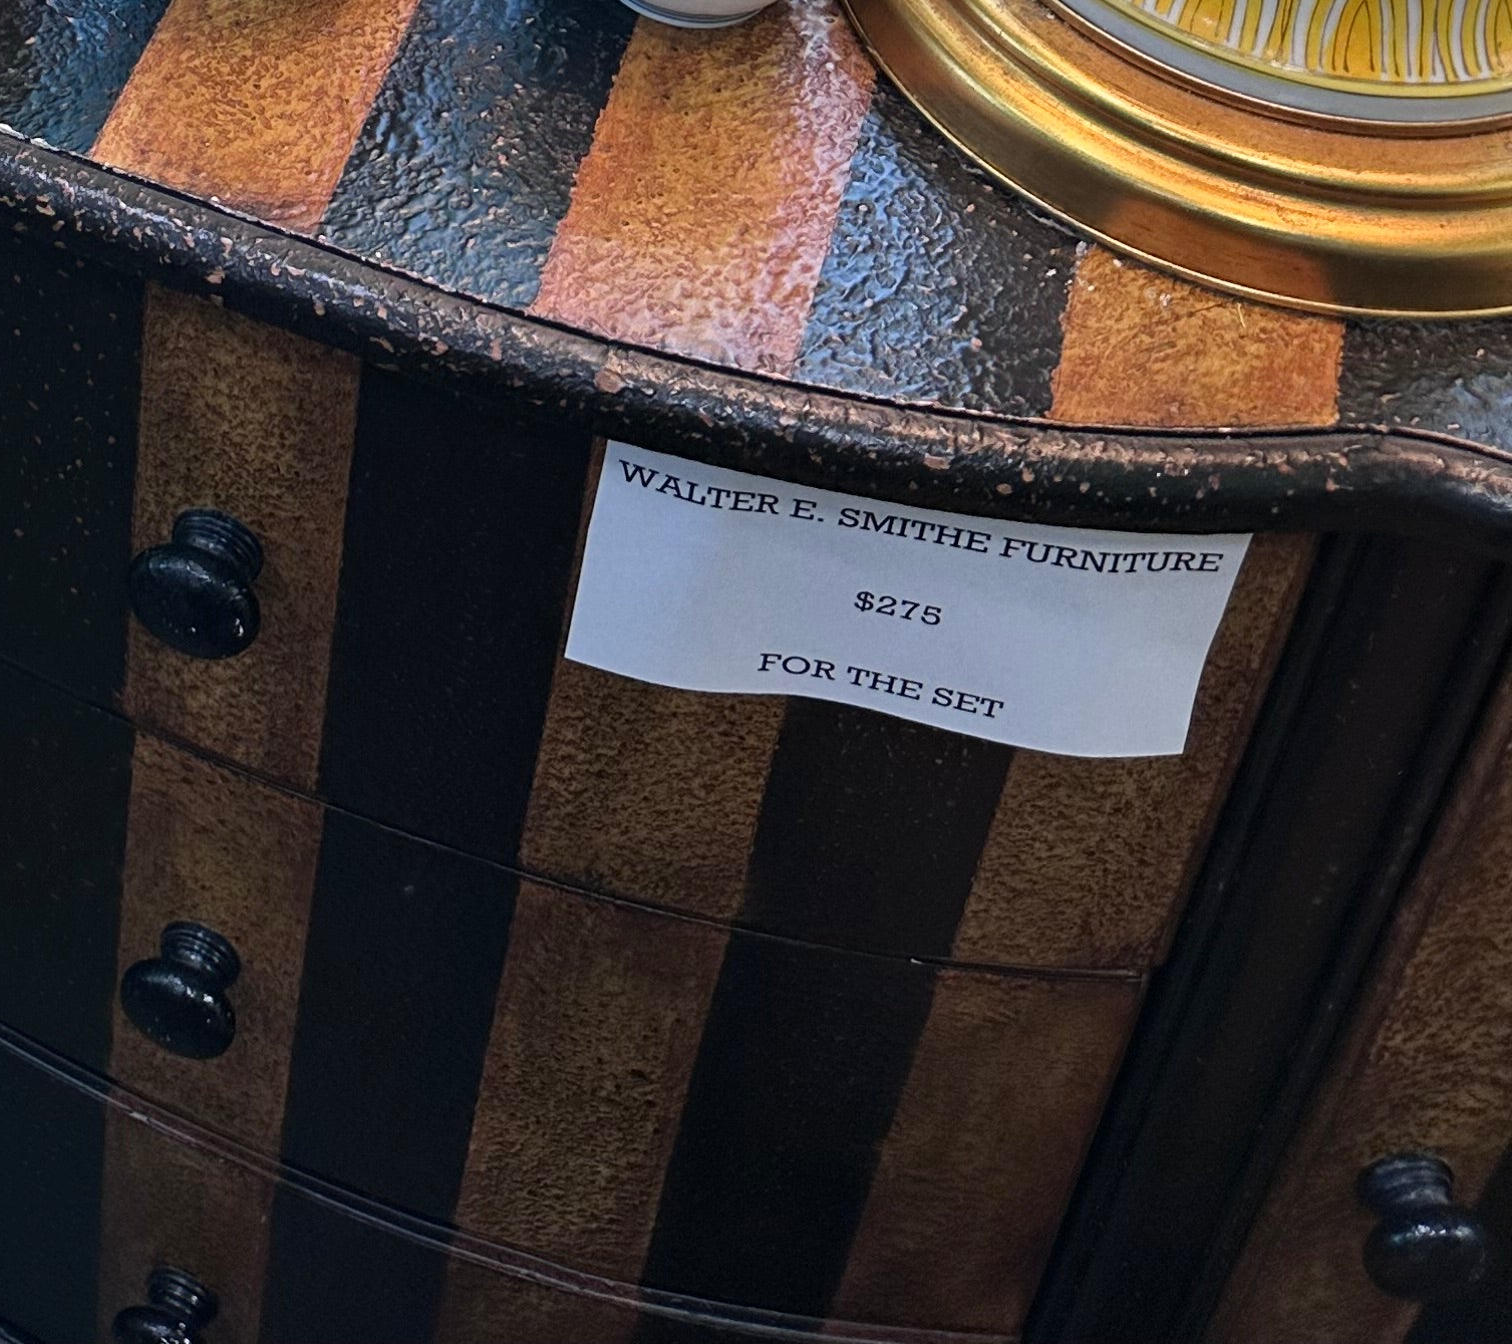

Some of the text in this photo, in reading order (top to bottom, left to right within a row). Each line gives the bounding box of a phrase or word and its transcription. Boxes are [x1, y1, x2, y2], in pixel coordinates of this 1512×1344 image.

[619, 459, 1224, 573] WALTER E. SMITHE FURNITURE
[854, 592, 941, 625] $275
[758, 653, 1004, 718] FOR THE SET
